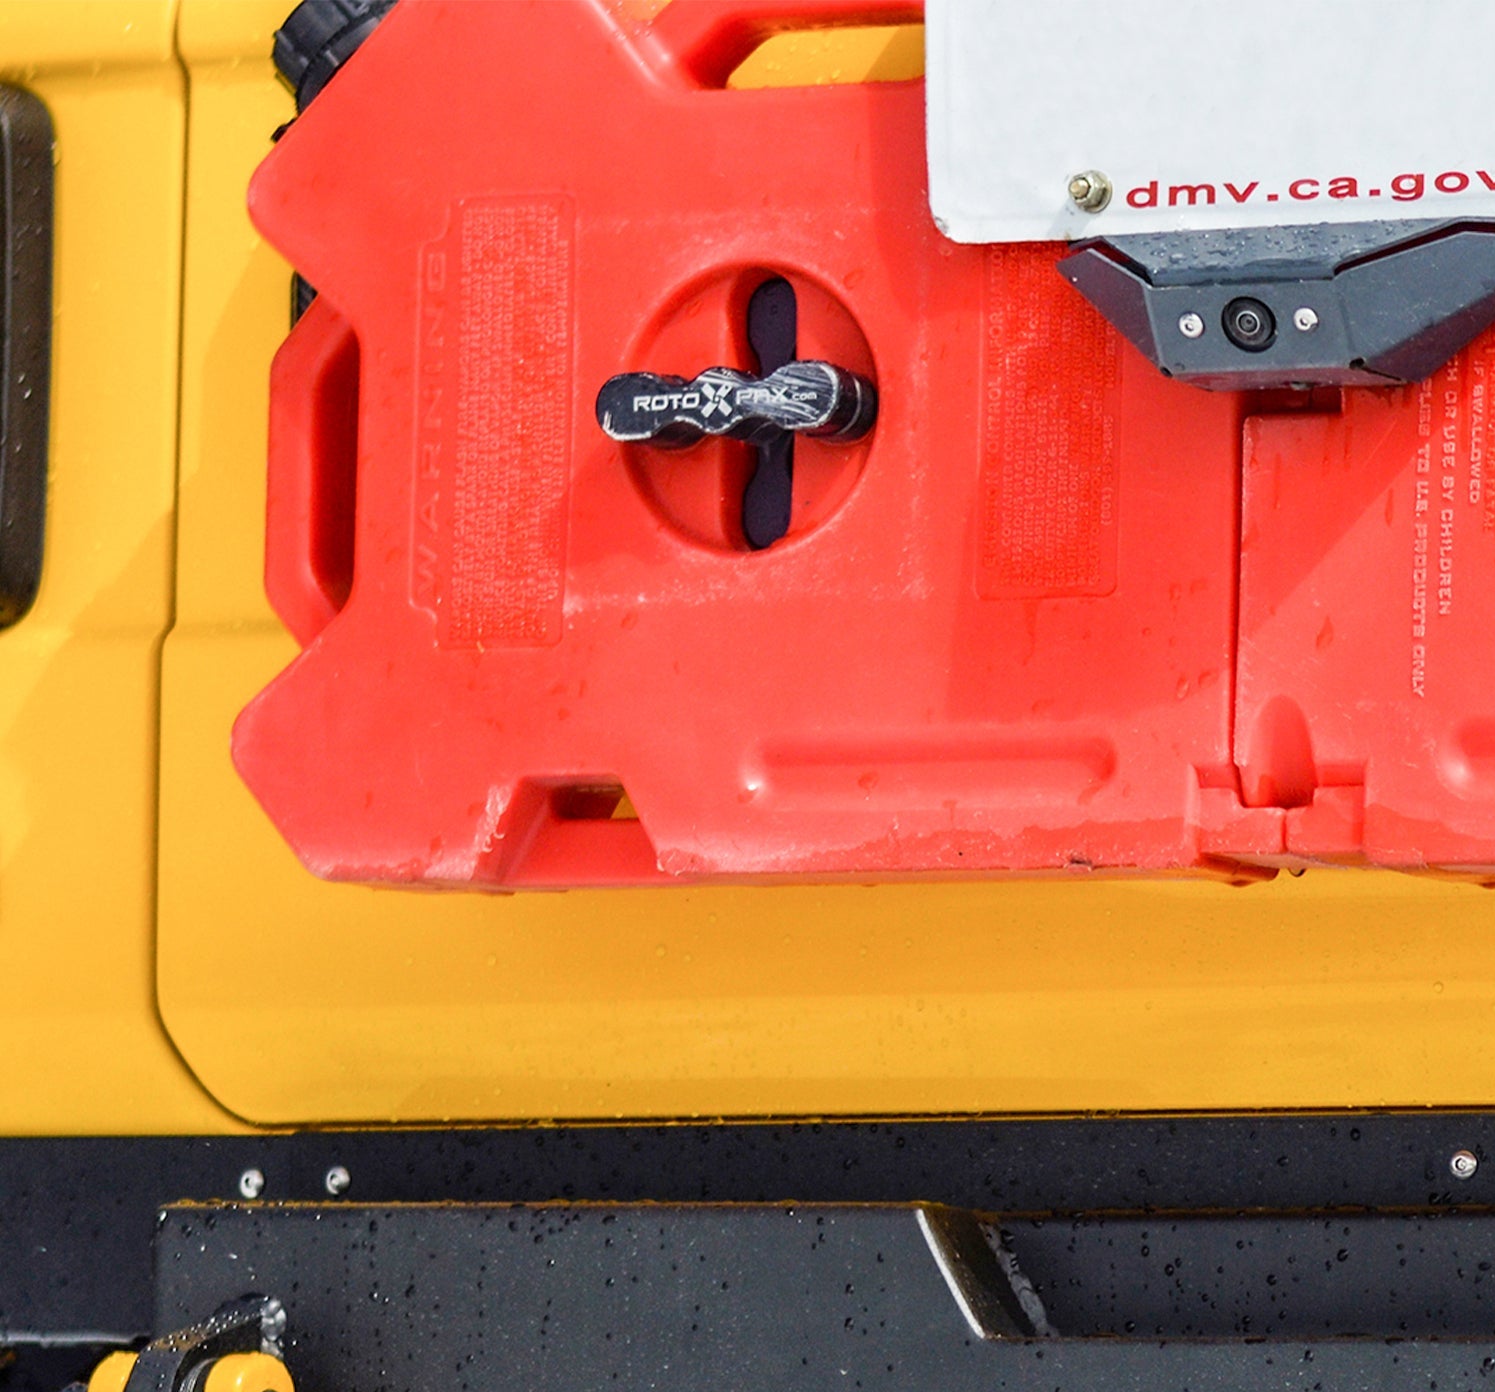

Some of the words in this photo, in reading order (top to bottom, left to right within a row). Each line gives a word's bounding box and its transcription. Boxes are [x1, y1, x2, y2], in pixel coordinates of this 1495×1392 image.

[1473, 360, 1485, 378] IF
[419, 251, 444, 594] WARNING
[632, 392, 700, 412] ROTO
[985, 376, 1002, 466] CONTROL
[1003, 388, 1015, 462] COMPLIES
[1417, 377, 1432, 437] PLIES
[1444, 390, 1458, 419] OR
[1416, 442, 1431, 473] TO
[1442, 425, 1456, 468] USE
[1469, 384, 1485, 504] SWALLOWED
[1001, 464, 1013, 547] CONTAINER
[1414, 480, 1429, 518] U.S.
[1440, 475, 1456, 501] BY
[984, 471, 999, 567] EMISSION
[1411, 522, 1429, 638] PRODUCTS
[1438, 508, 1454, 616] CHILDREN
[1411, 644, 1426, 699] ONLY
